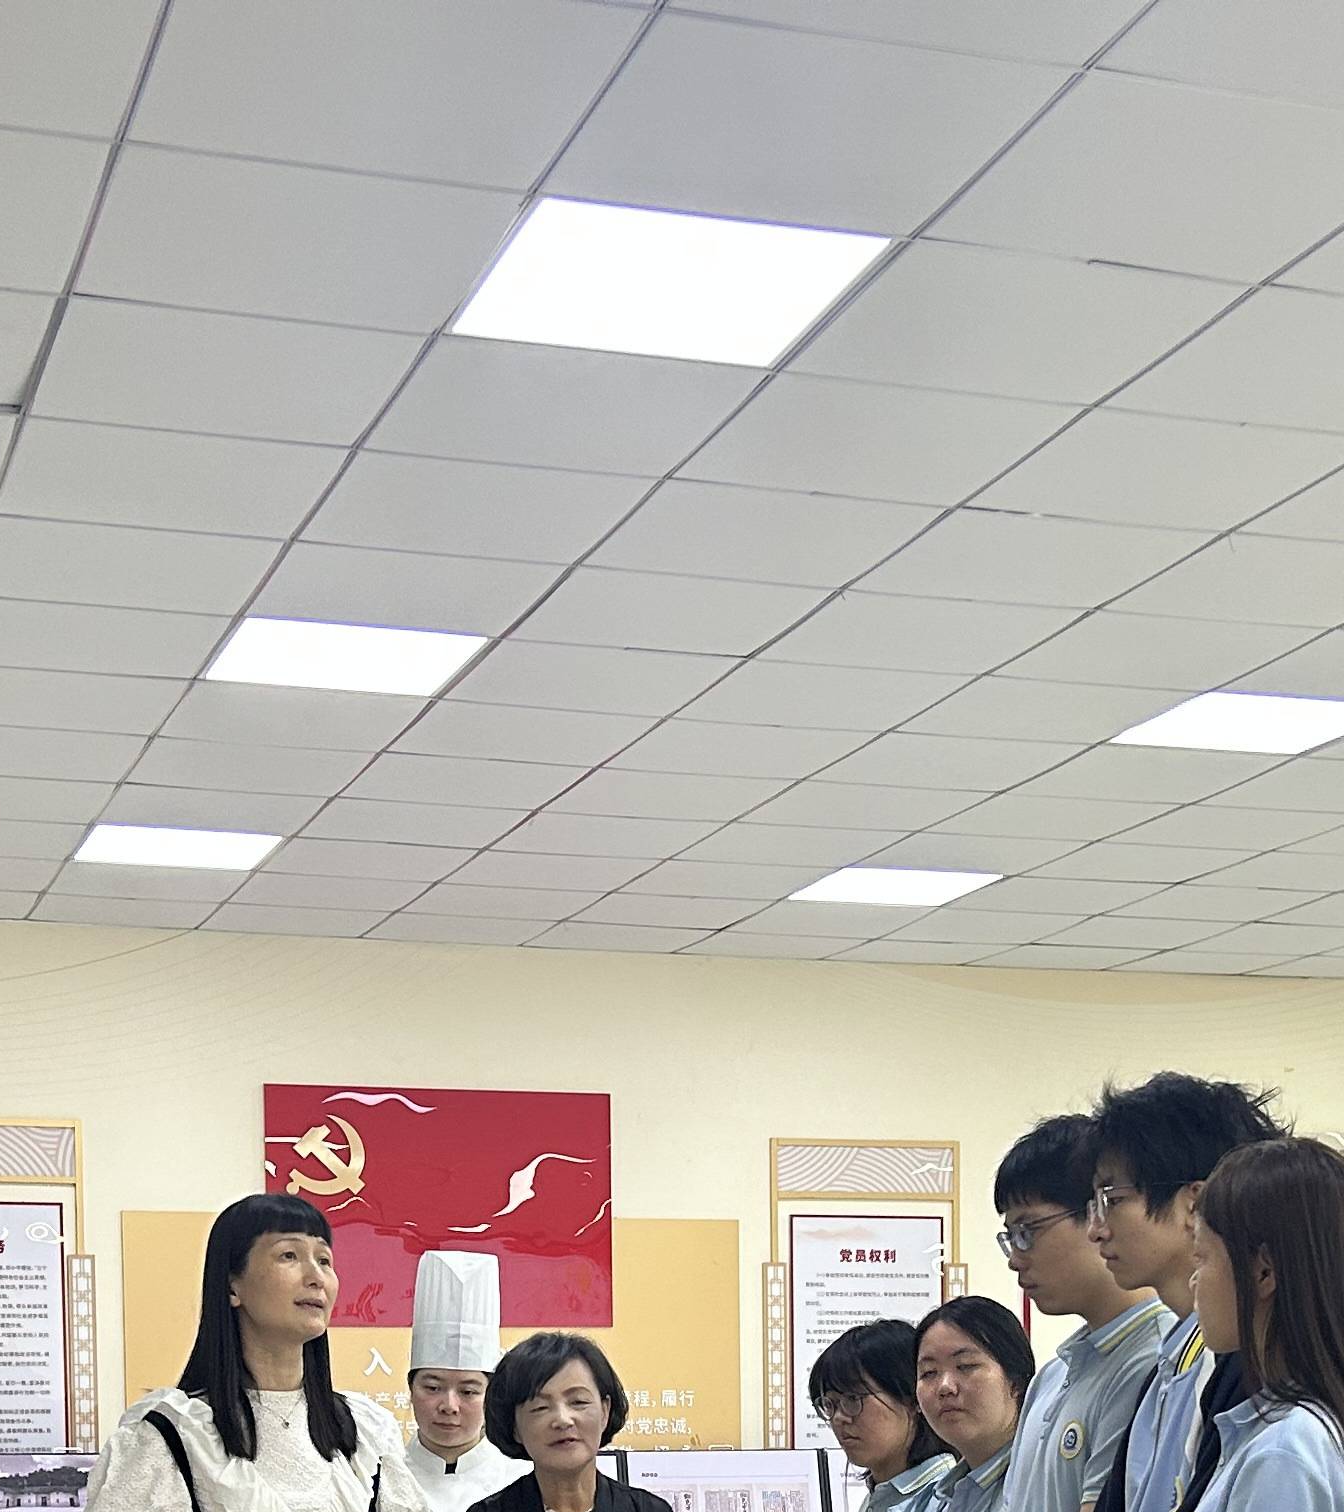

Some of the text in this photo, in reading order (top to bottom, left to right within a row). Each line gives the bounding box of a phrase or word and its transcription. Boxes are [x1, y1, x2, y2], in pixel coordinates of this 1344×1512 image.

[839, 1248, 897, 1263] 党员权利
[364, 1348, 393, 1376] 入
